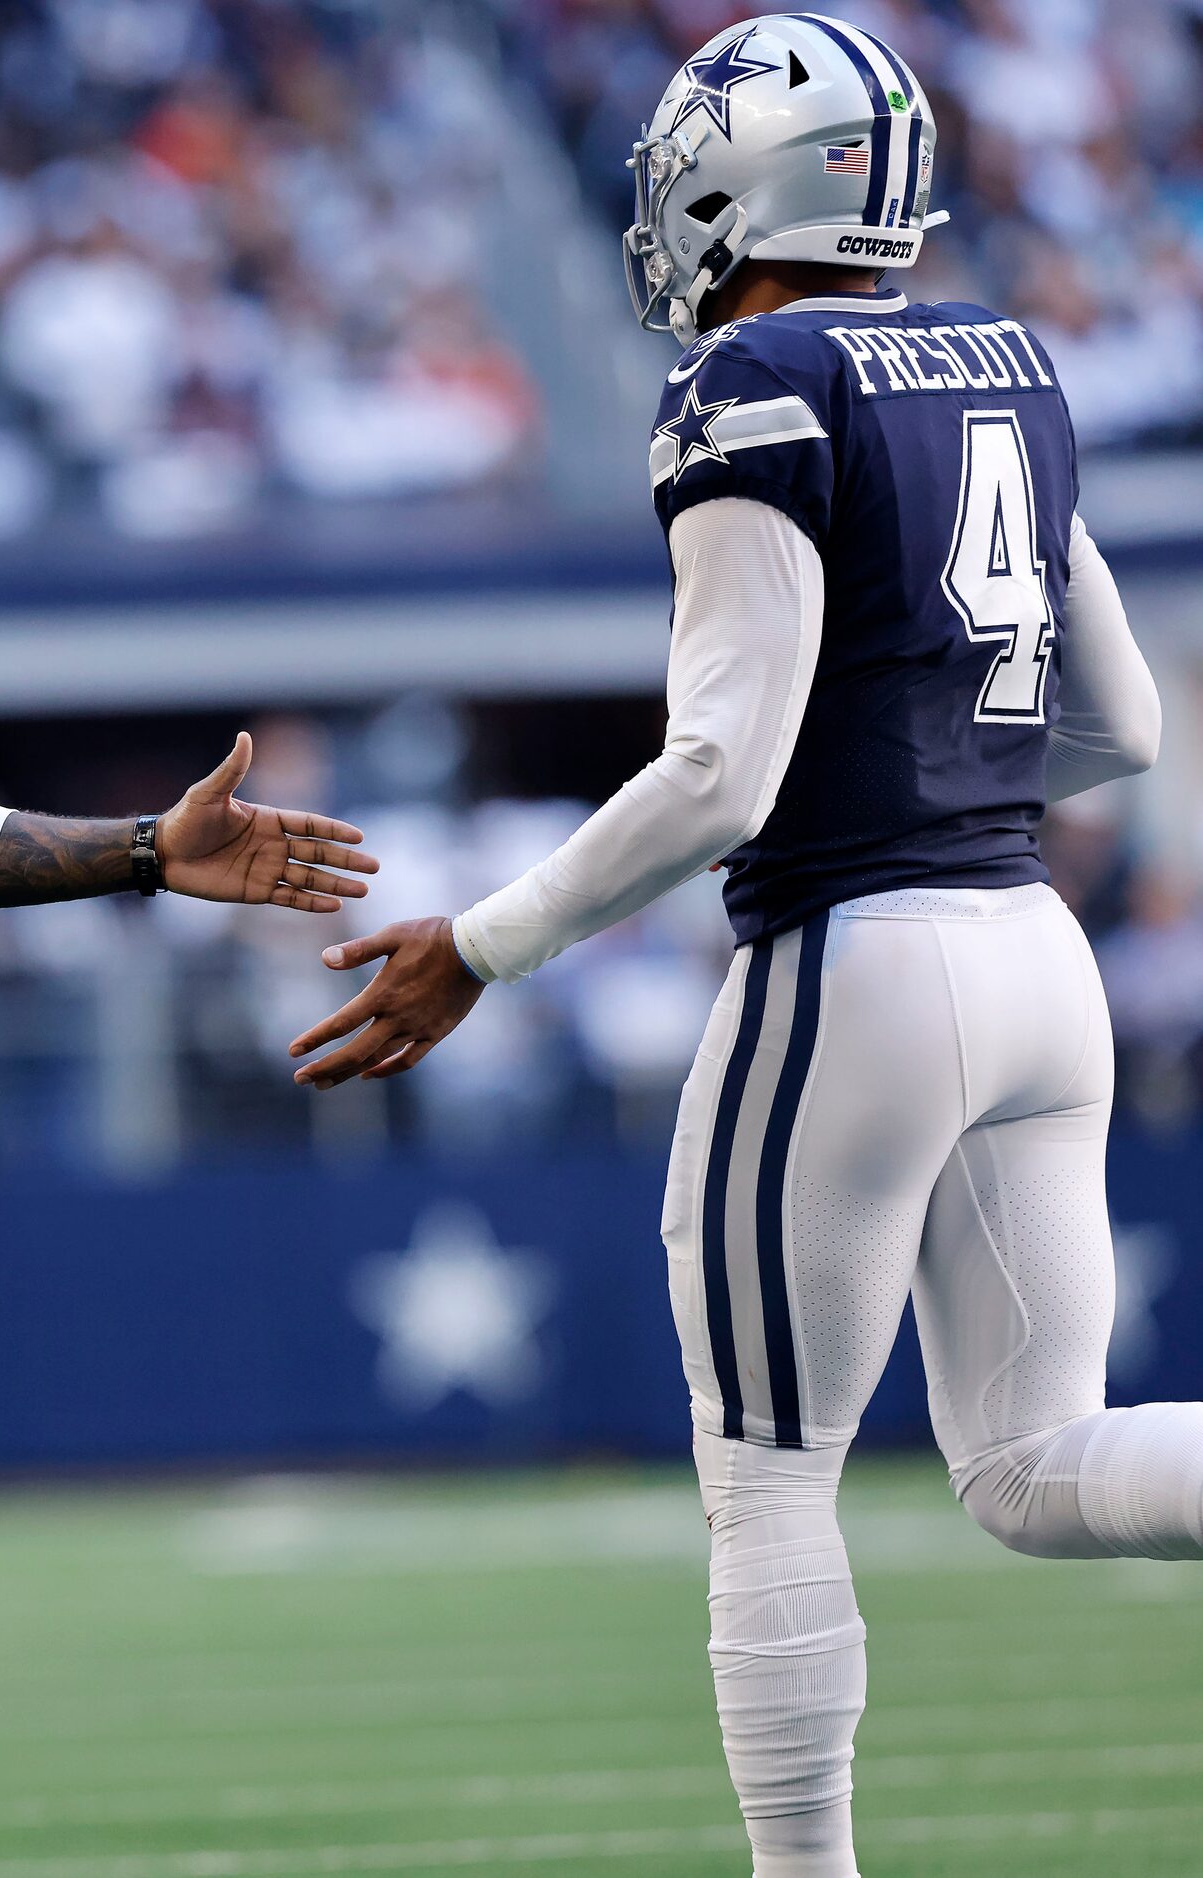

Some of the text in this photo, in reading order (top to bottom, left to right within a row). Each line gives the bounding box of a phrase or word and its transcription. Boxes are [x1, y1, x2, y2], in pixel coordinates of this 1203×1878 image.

[836, 235, 914, 259] COWBOYS
[823, 320, 1053, 396] PRESCOTT
[940, 409, 1055, 725] 4
